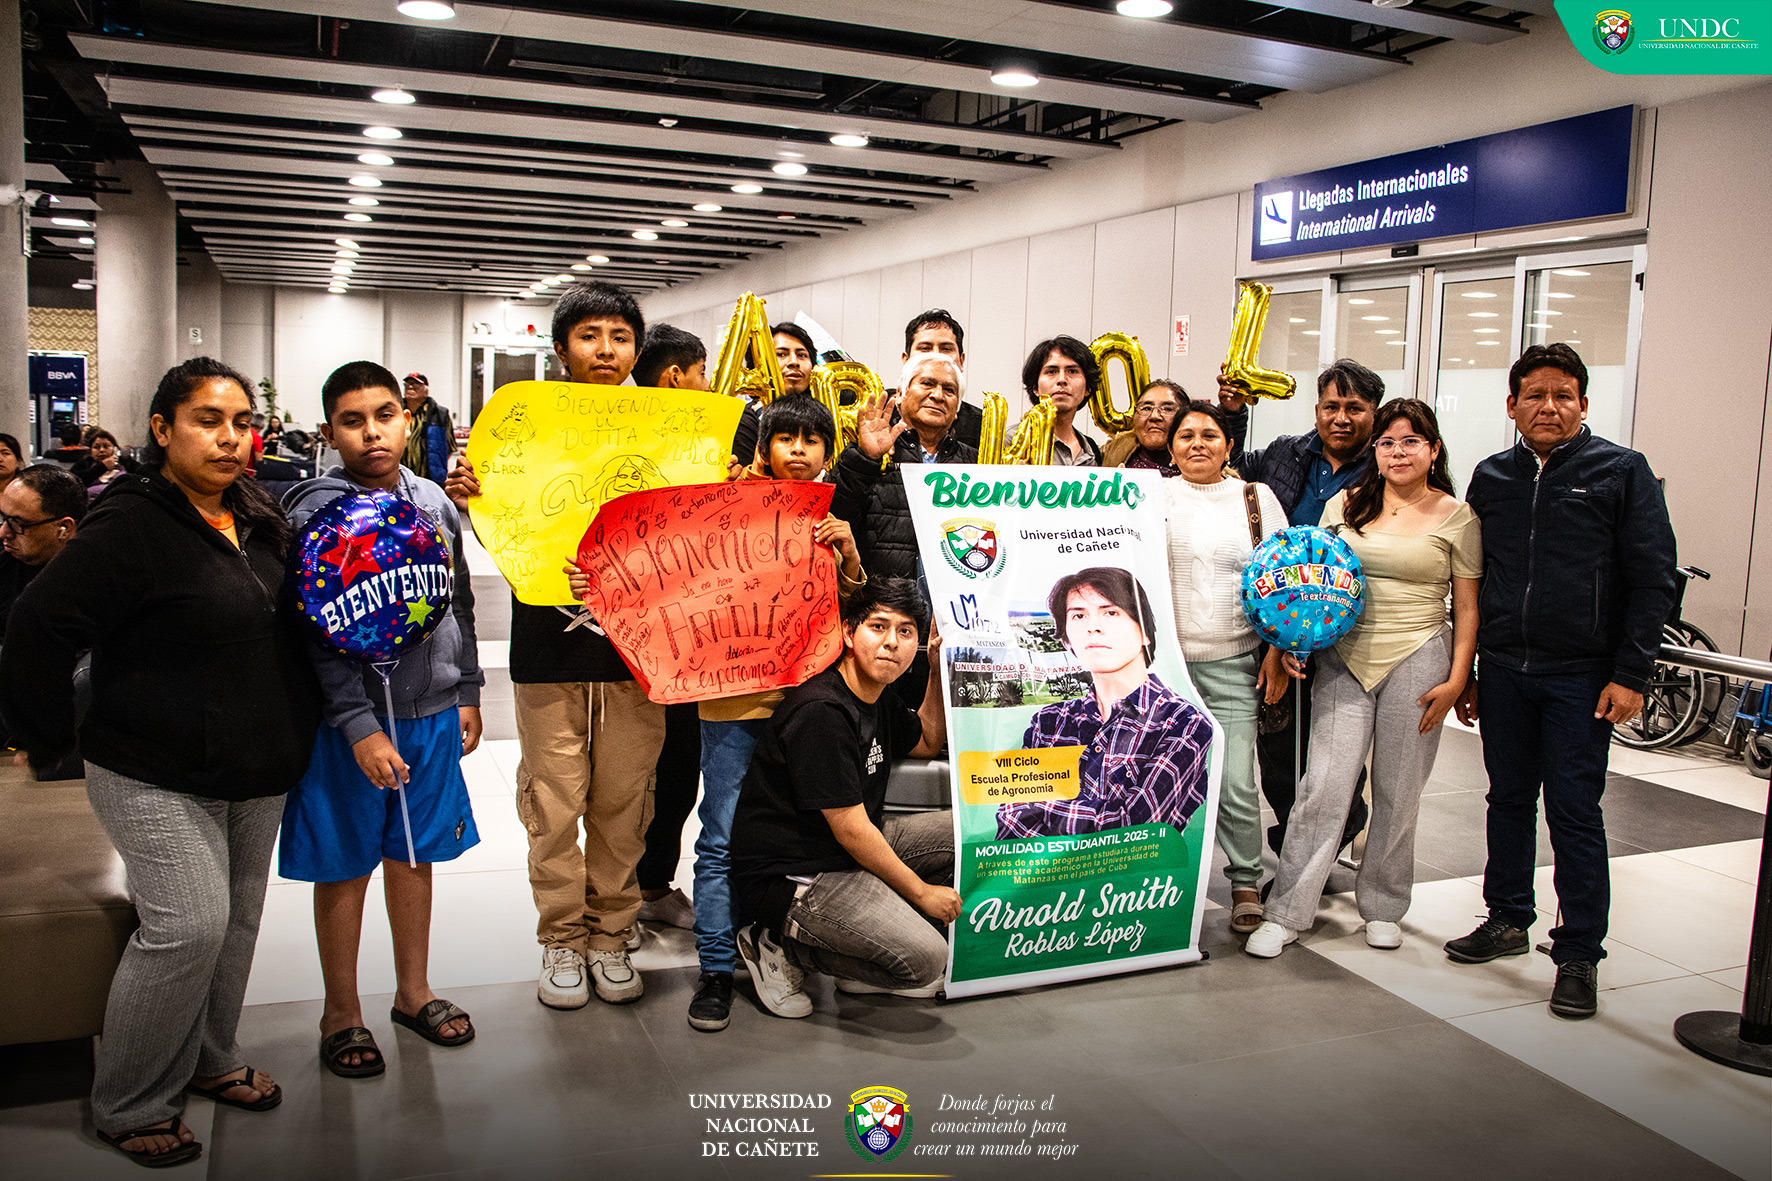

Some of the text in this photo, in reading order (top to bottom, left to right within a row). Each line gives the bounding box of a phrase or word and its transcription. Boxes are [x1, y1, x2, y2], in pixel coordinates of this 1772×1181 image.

[1299, 163, 1468, 211] Llegadas Internacionales
[1296, 201, 1436, 241] International Arrivals
[48, 371, 77, 379] BBVA
[480, 461, 525, 474] SLARK
[924, 471, 1146, 509] Bienvenido
[668, 492, 683, 508] Te
[1019, 525, 1142, 542] Universidad Nacional
[1057, 541, 1120, 554] de Cañete
[320, 564, 455, 635] BIENVENIDO
[1300, 592, 1309, 601] Te
[955, 663, 1015, 671] UNIVERSIDAD
[996, 757, 1040, 768] VIII Ciclo
[971, 770, 1070, 784] Escuela Profesional
[988, 784, 1054, 797] de Agronomía
[975, 842, 1045, 857] MOVILIDAD
[1048, 834, 1121, 853] ESTUDIANTIL
[1123, 830, 1149, 842] 2025
[988, 867, 1031, 877] semestre
[1093, 859, 1101, 867] la
[1102, 852, 1148, 865] Universidad
[1149, 850, 1159, 858] de
[1015, 859, 1026, 867] de
[1029, 858, 1050, 867] este
[1052, 853, 1091, 866] programa
[1130, 843, 1160, 854] durante
[1013, 875, 1056, 885] Matanzas
[1070, 870, 1078, 879] el
[1097, 866, 1107, 874] de
[1108, 863, 1128, 873] Cuba
[969, 875, 1184, 933] Arnold Smith
[1004, 919, 1148, 958] Robles López
